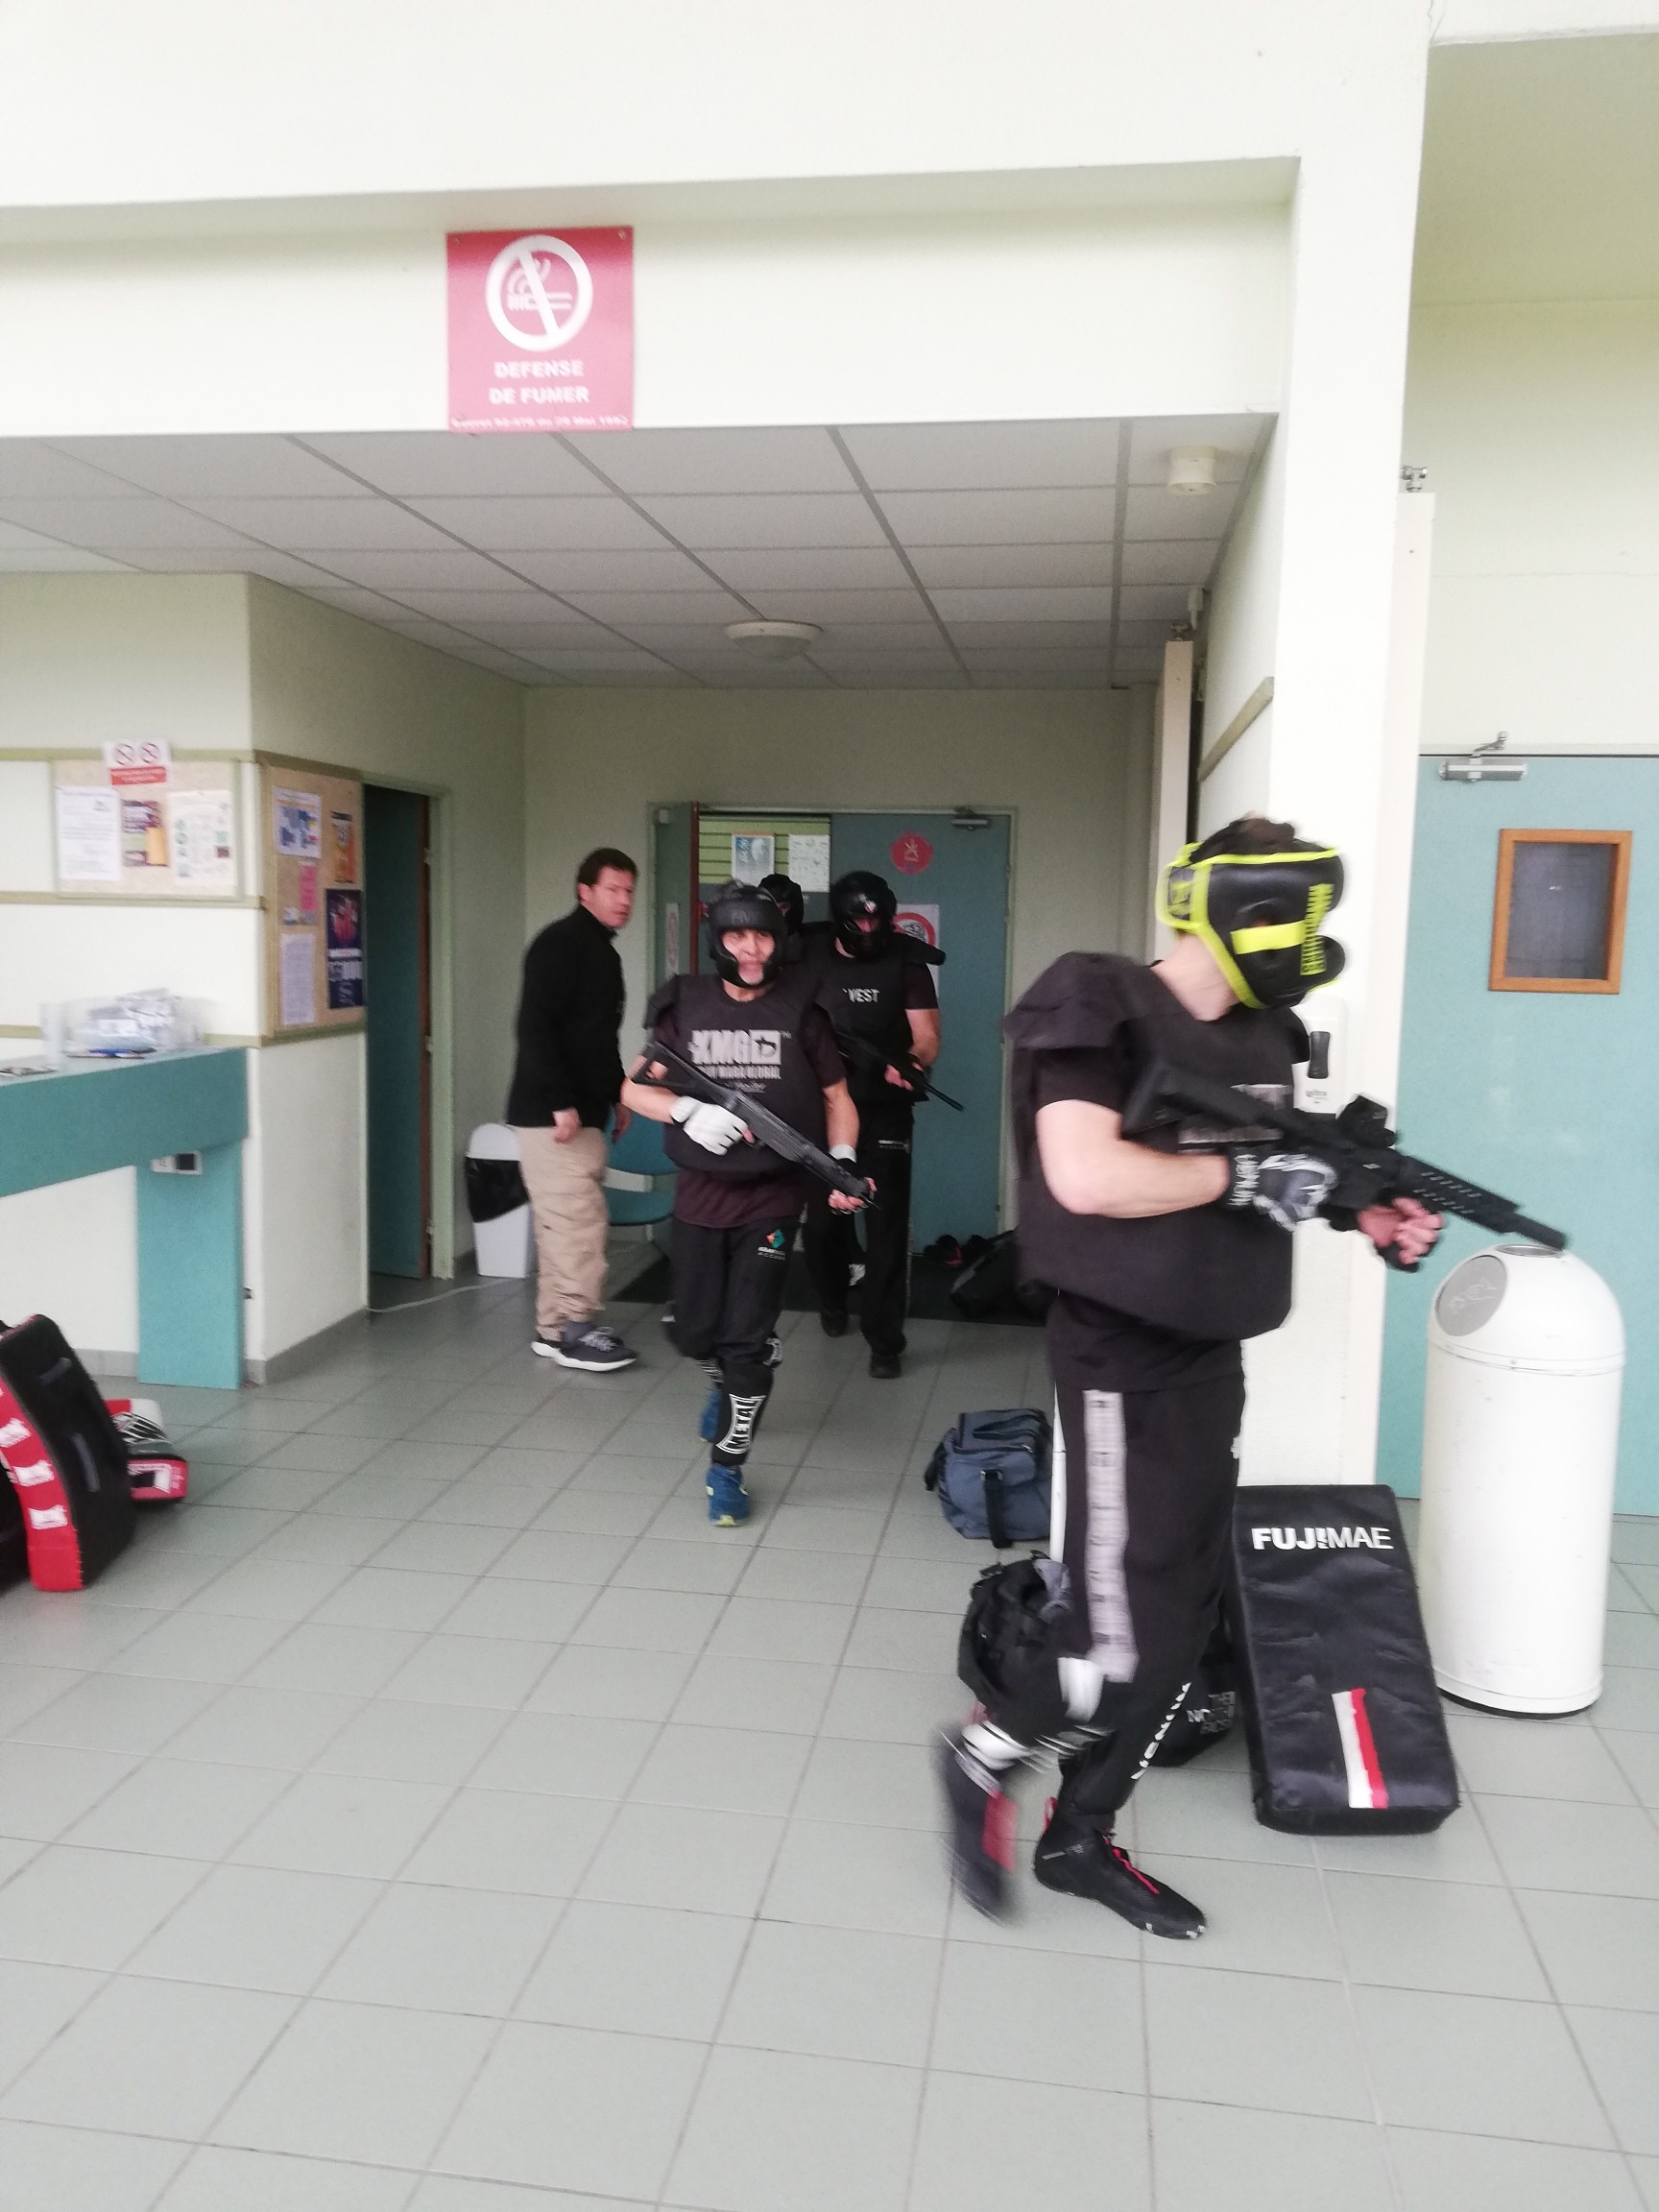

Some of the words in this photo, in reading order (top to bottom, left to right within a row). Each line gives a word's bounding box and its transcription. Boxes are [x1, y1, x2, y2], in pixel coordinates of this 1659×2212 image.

[494, 359, 585, 378] DEFENSE
[489, 387, 516, 405] DE
[519, 385, 590, 404] FUMER
